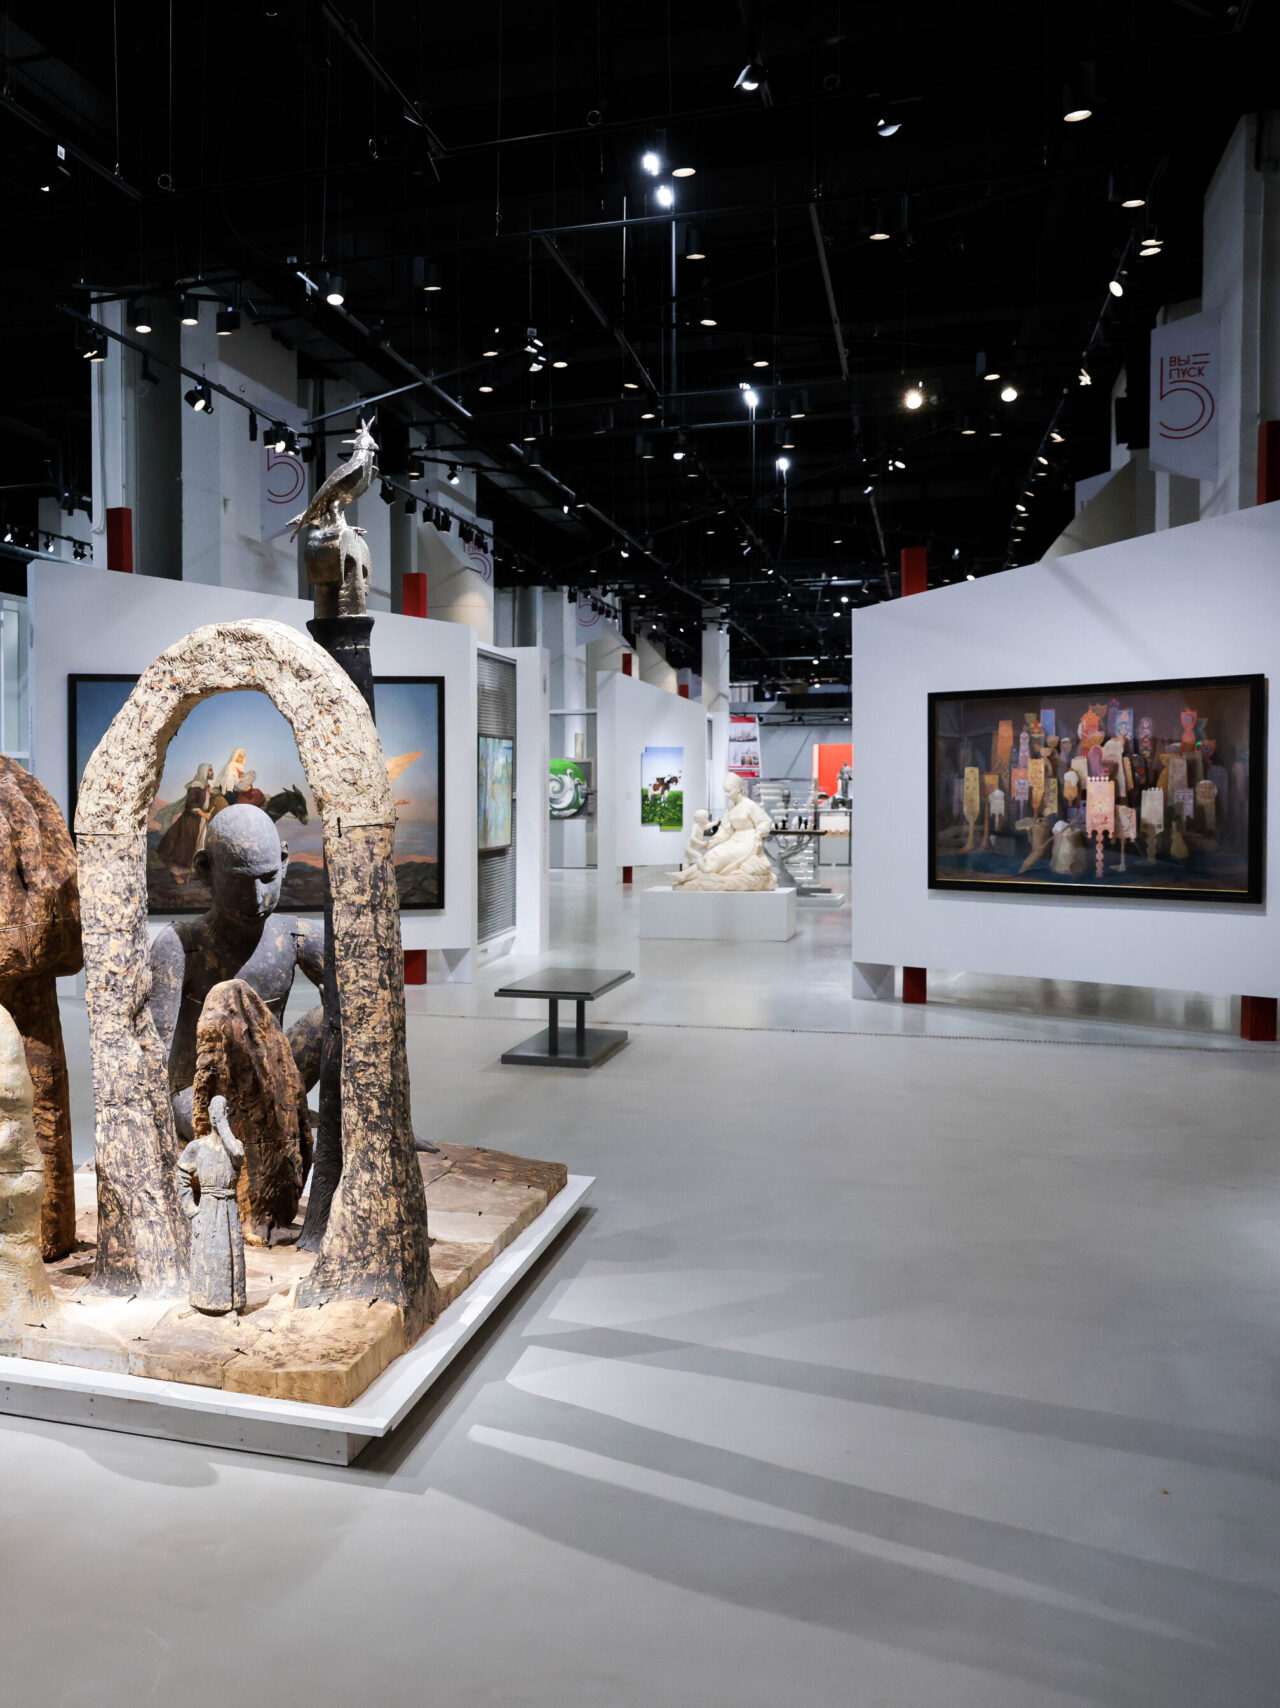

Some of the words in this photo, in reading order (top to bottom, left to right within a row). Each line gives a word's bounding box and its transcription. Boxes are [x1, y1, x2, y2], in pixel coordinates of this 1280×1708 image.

[1169, 354, 1190, 367] ВЫ
[1169, 366, 1205, 379] ПУСК
[1159, 353, 1215, 440] 5
